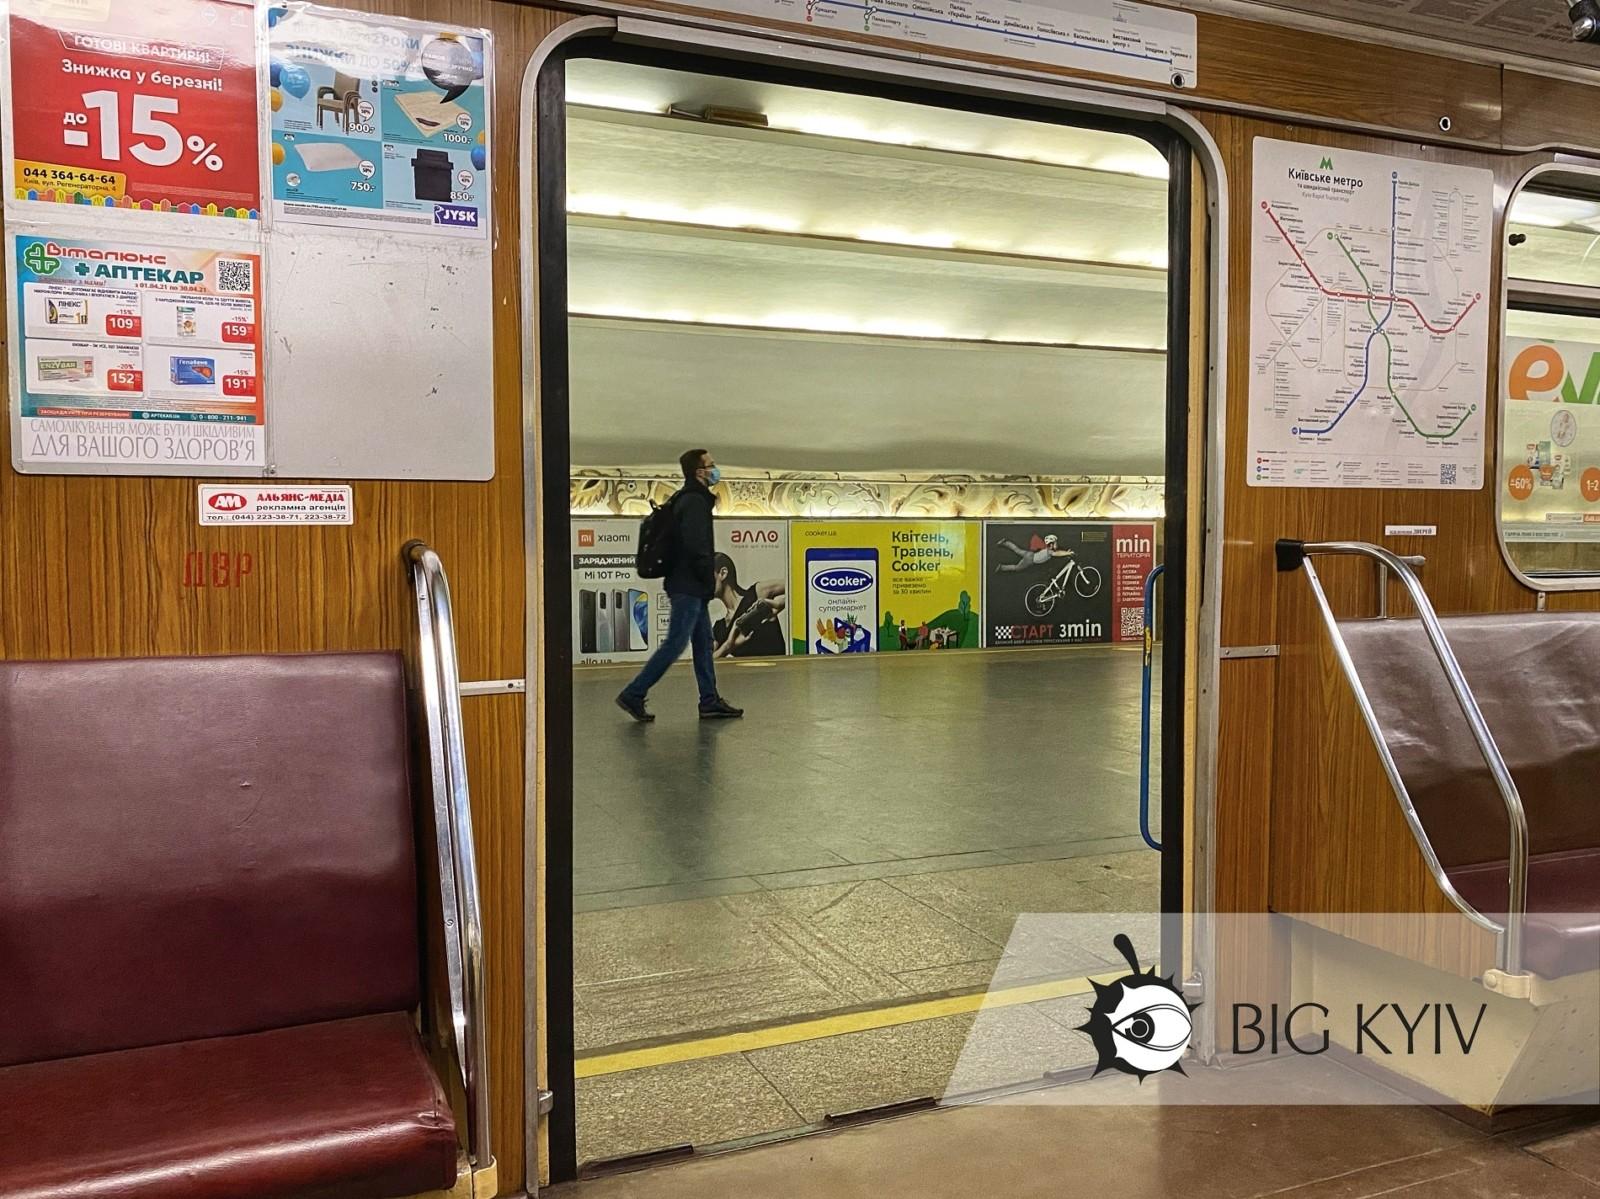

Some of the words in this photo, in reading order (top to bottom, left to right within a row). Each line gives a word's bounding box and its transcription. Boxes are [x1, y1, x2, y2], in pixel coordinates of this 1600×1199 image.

[74, 35, 128, 54] ГОТОВІ
[61, 58, 131, 80] Знижка
[136, 71, 146, 84] у
[151, 71, 223, 92] березні!
[63, 110, 87, 125] до
[23, 168, 47, 178] 044
[51, 170, 115, 185] 364-64-64
[1288, 168, 1331, 184] Київське
[1333, 176, 1364, 190] метро
[443, 209, 476, 222] JYSK
[94, 264, 204, 285] АПТЕКАР
[109, 317, 134, 329] 109
[224, 325, 247, 337] 159
[111, 373, 135, 384] 152
[225, 378, 247, 390] 191
[31, 418, 130, 436] САМОЛІКУВАННЯ
[128, 421, 160, 436] МОЖЕ
[164, 423, 190, 437] БУТИ
[193, 424, 255, 438] ШКІДЛИВИМ
[32, 434, 69, 456] ДЛЯ
[77, 435, 158, 459] ВАШОГО
[165, 438, 255, 461] ЗДОРОВ'Я
[257, 492, 344, 504] АЛЬЯНС-МЕДІА
[256, 504, 306, 512] рекламна
[309, 504, 346, 512] агенція
[597, 531, 630, 543] xiaomi
[892, 530, 949, 544] Квітень,
[1116, 534, 1150, 553] min
[892, 545, 954, 560] Травень,
[578, 556, 636, 565] ЗАРЯДЖЕНИЙ
[892, 560, 941, 572] Cooker
[584, 570, 596, 579] Mi
[597, 571, 612, 579] 10T
[615, 571, 631, 580] Pro
[820, 576, 867, 587] Cooker
[827, 597, 858, 605] онлайн-
[818, 605, 867, 613] супермаркет
[1011, 624, 1054, 639] СТАРТ
[1059, 618, 1102, 638] 3min
